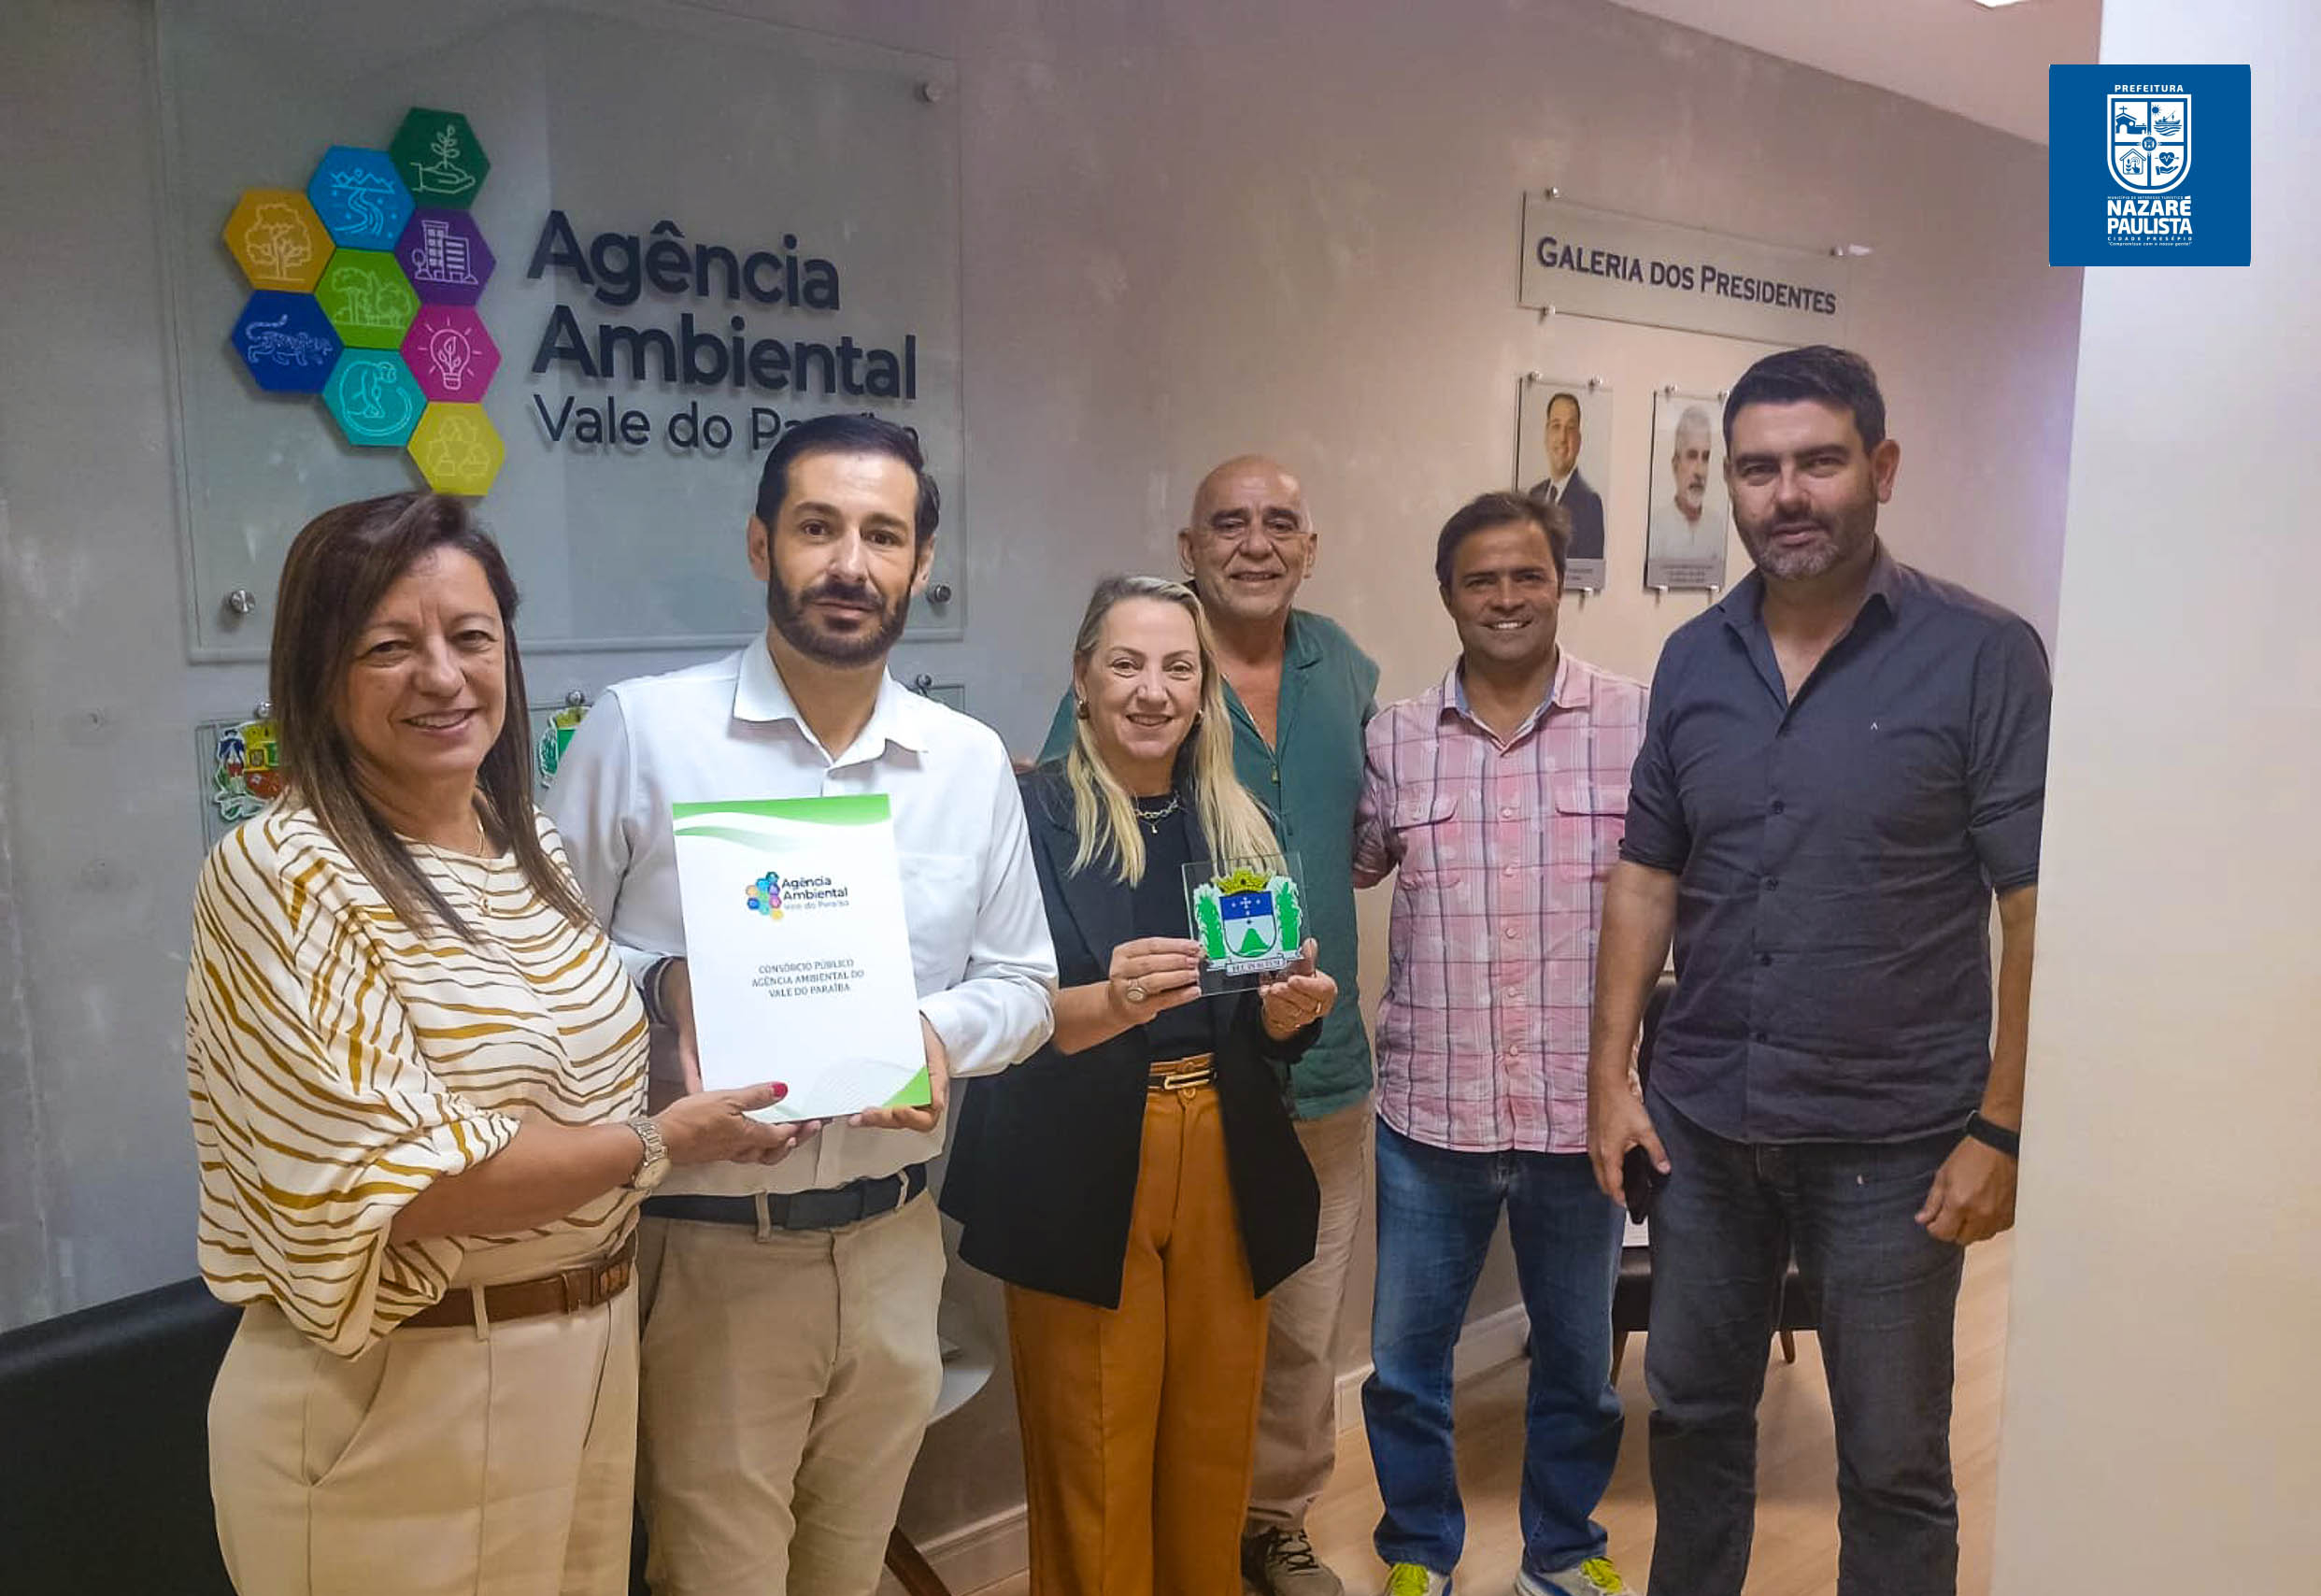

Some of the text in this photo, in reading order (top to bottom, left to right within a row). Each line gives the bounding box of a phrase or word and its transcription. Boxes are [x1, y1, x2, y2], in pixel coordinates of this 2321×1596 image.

[526, 209, 840, 310] Agência
[1536, 235, 1644, 283] GALERIA
[1700, 265, 1837, 315] PRESIDENTES
[532, 304, 917, 400] Ambiental
[533, 393, 651, 445] Vale
[668, 401, 733, 449] do
[781, 876, 832, 891] Agência
[783, 886, 848, 901] Ambiental
[814, 959, 854, 970] PÚBLICO
[751, 969, 865, 988] AGÊNCIA AMBIENTAL DO
[768, 982, 850, 998] VALE DO PARAÍBA
